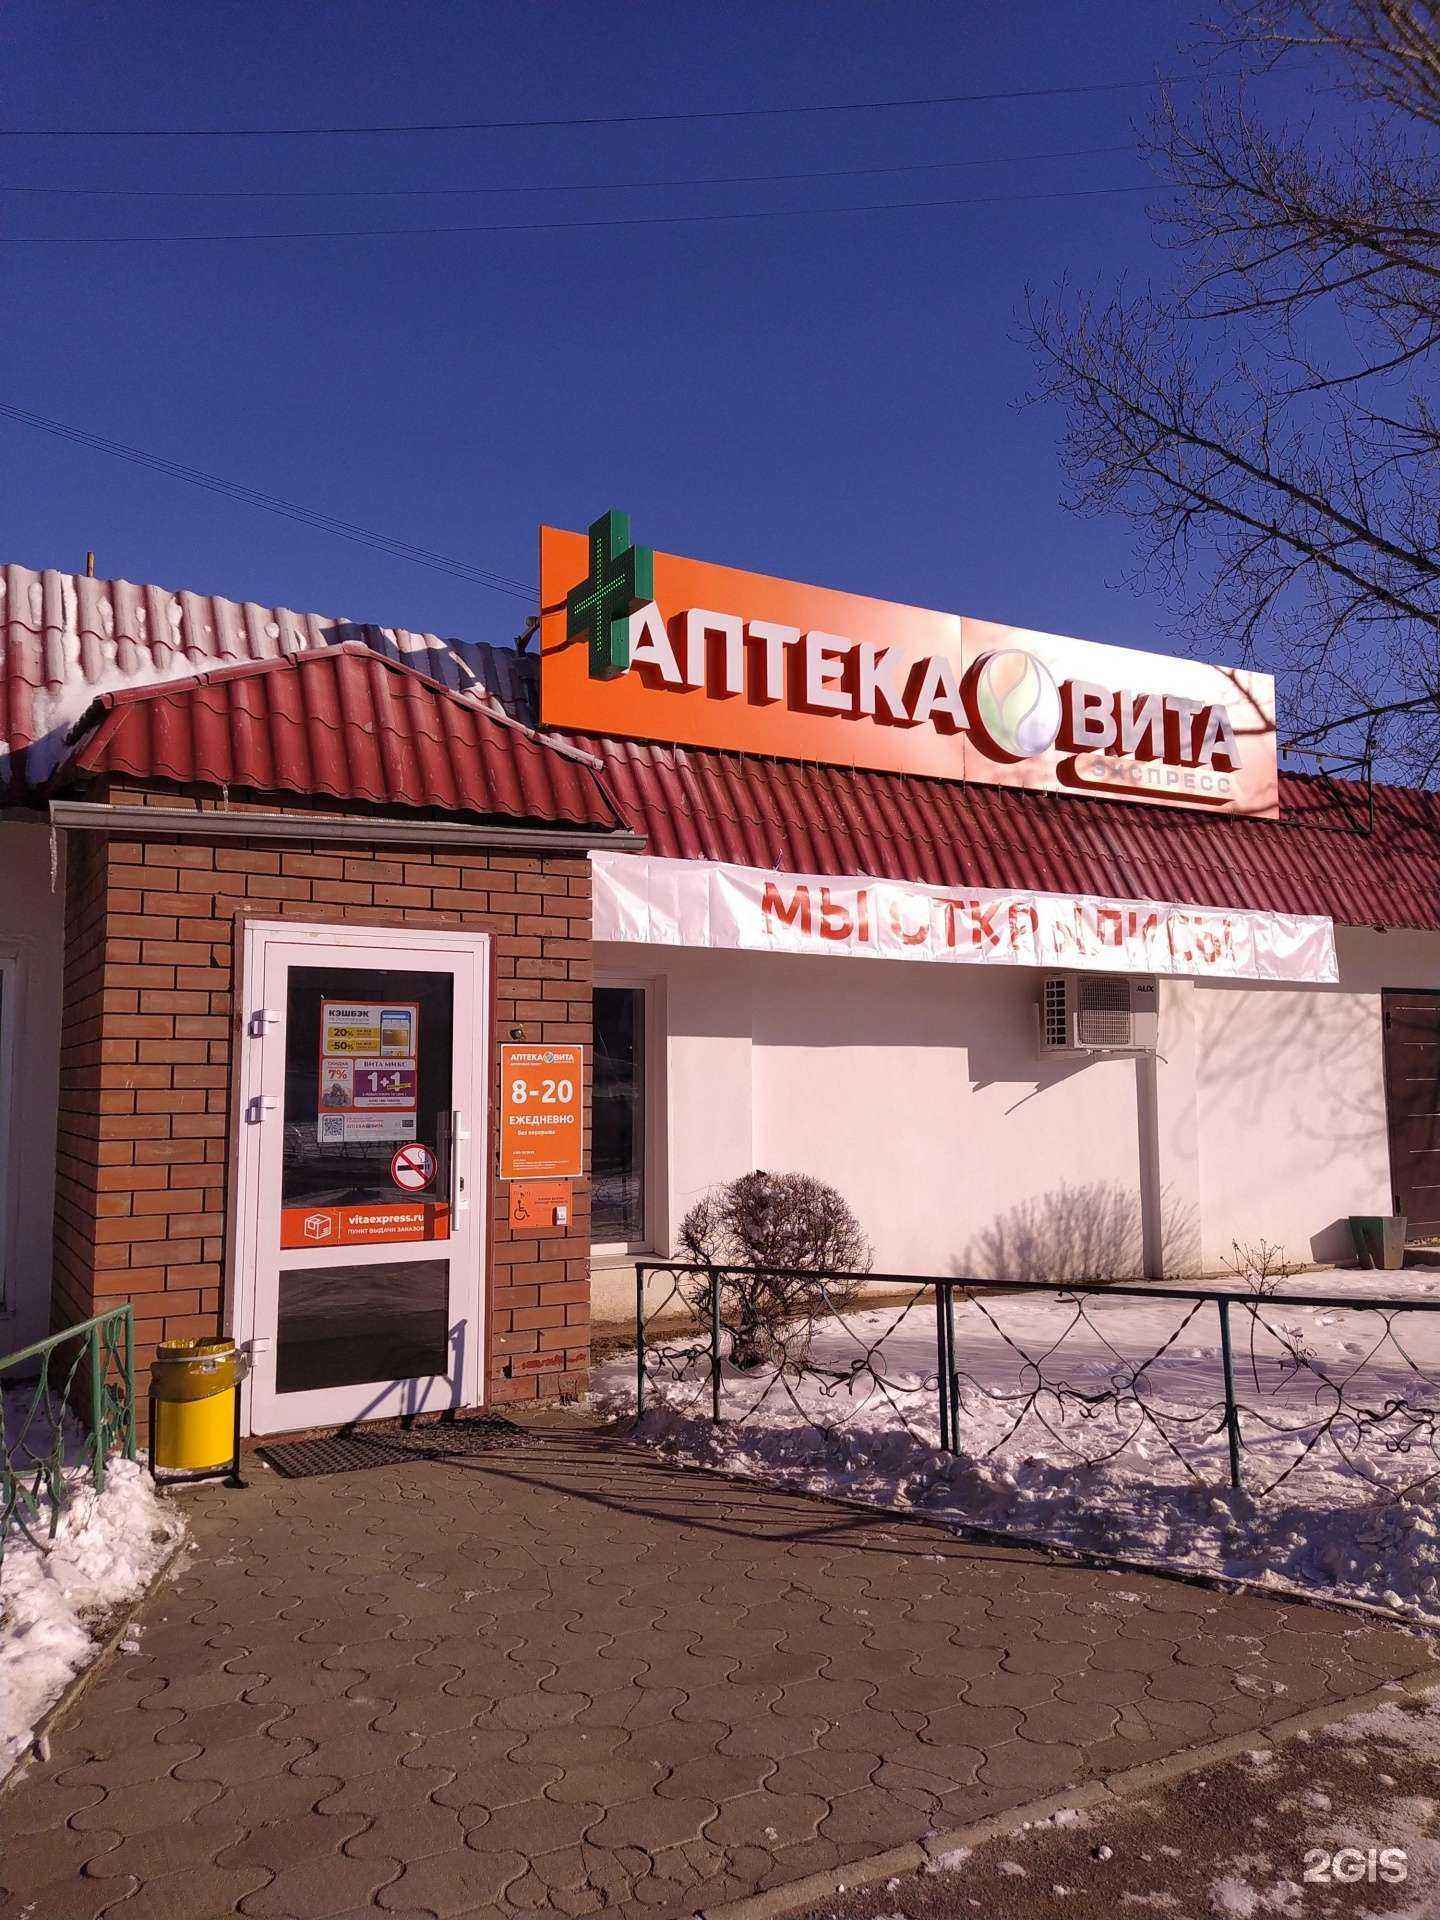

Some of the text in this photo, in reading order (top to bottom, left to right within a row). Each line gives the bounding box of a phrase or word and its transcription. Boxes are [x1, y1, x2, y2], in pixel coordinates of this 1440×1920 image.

[624, 600, 1242, 769] АПТЕКА ВИТА
[1093, 759, 1232, 794] ЭКСПРЕСС
[761, 881, 869, 942] МЫ
[1136, 985, 1155, 993] AUX
[328, 1009, 370, 1018] КЭШБЭК
[510, 1053, 575, 1062] АПТЕКА ВИТА
[328, 1069, 348, 1079] 7%
[367, 1071, 402, 1092] 1+1
[511, 1079, 574, 1105] 8-20
[509, 1114, 575, 1126] ЕЖЕДНЕВНО
[348, 1213, 425, 1225] vitaexpress.ru
[347, 1225, 425, 1236] ПУНКТ ВЫДАЧИ ЗАКАЗОВ
